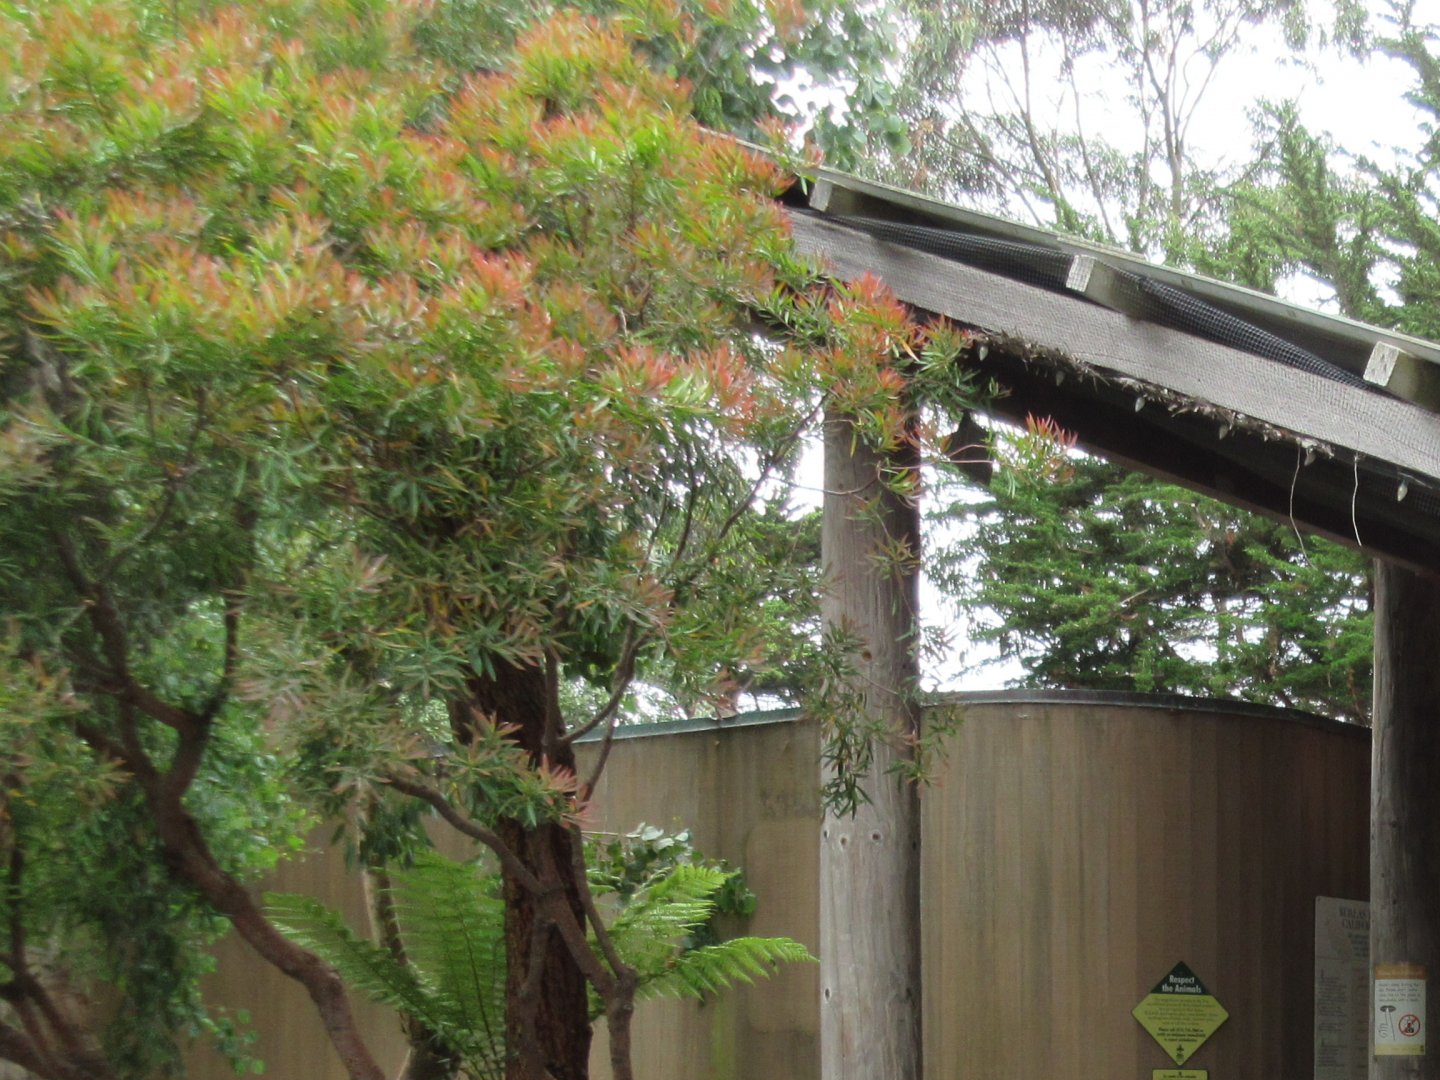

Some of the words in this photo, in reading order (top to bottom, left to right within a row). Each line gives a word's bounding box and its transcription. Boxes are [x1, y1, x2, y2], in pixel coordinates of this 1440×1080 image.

[1169, 974, 1195, 985] Respect
[1162, 984, 1173, 993] the
[1174, 984, 1201, 993] Animals
